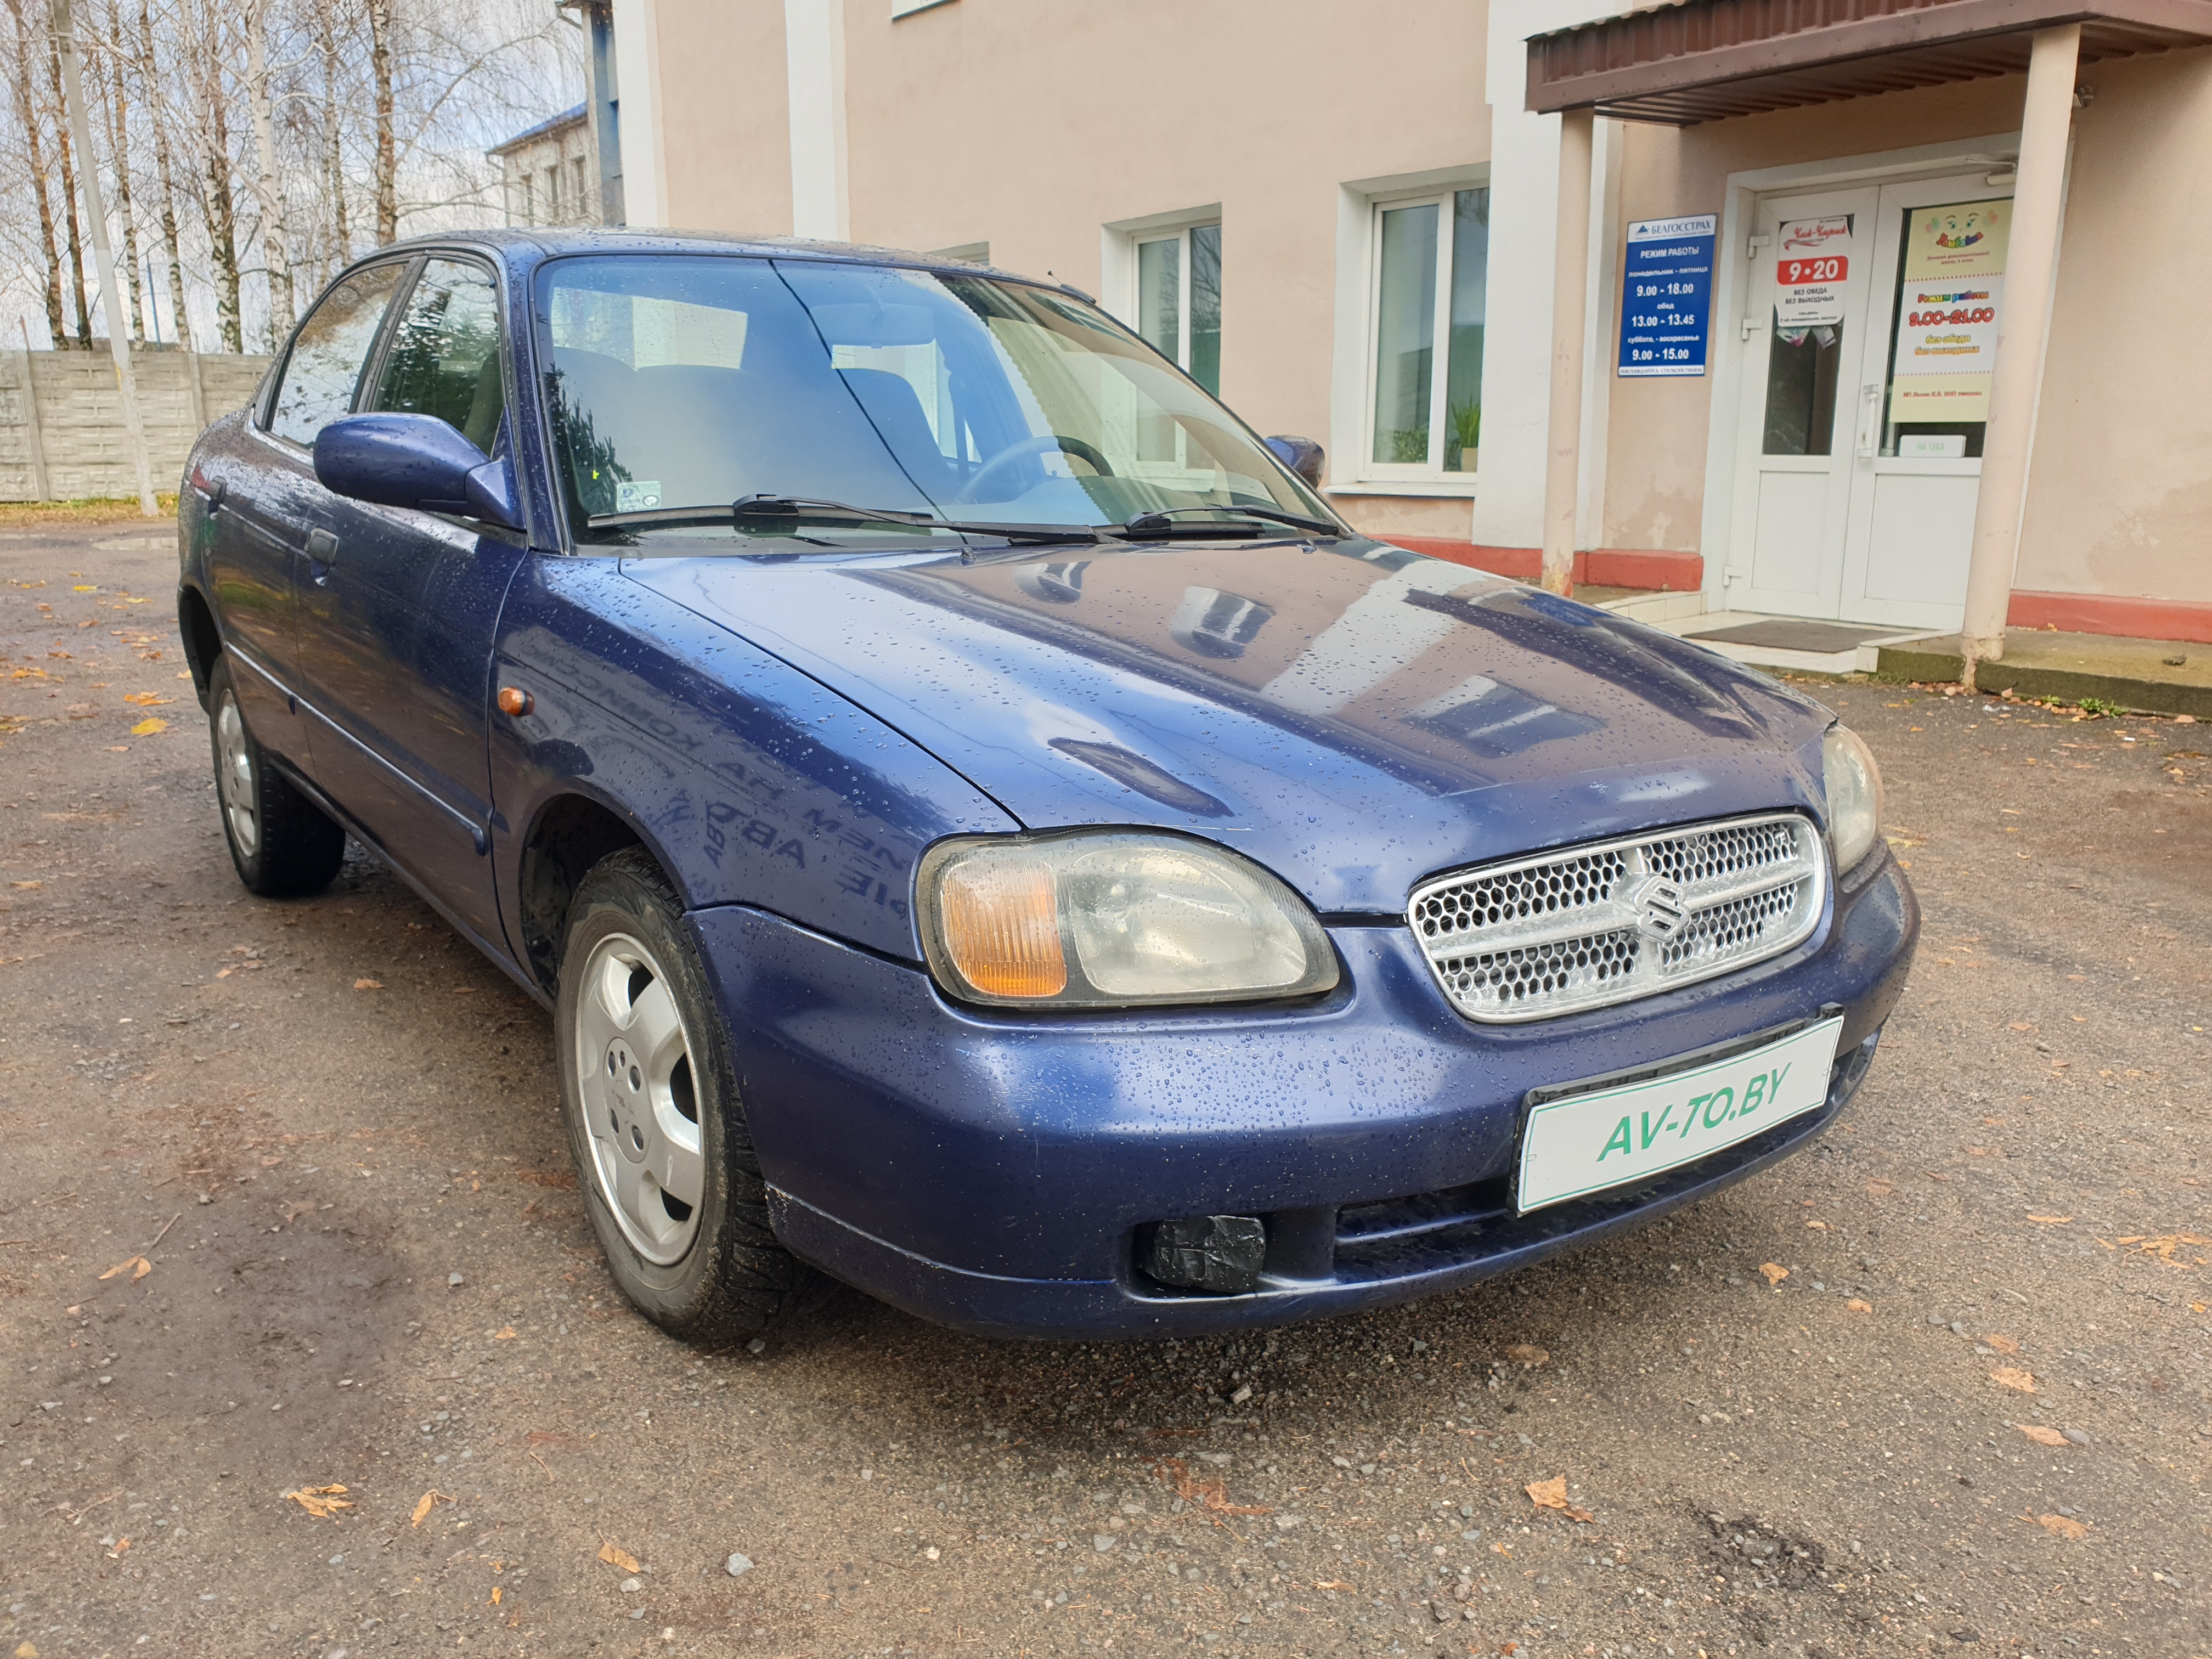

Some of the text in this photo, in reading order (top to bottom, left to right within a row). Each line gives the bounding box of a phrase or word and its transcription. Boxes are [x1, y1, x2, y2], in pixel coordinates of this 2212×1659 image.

[1651, 219, 1711, 235] БЕЛГОССТРАХ
[1640, 246, 1699, 258] РЕЖИМ РАБОТЫ
[1637, 284, 1657, 297] 9.00
[1667, 283, 1694, 295] 18.00
[1632, 315, 1658, 327] 13.00
[1667, 314, 1695, 326] 13.45
[1632, 349, 1653, 361] 9.00
[1662, 348, 1689, 360] 15.00
[1596, 1062, 1792, 1162] AV-TO.BY
